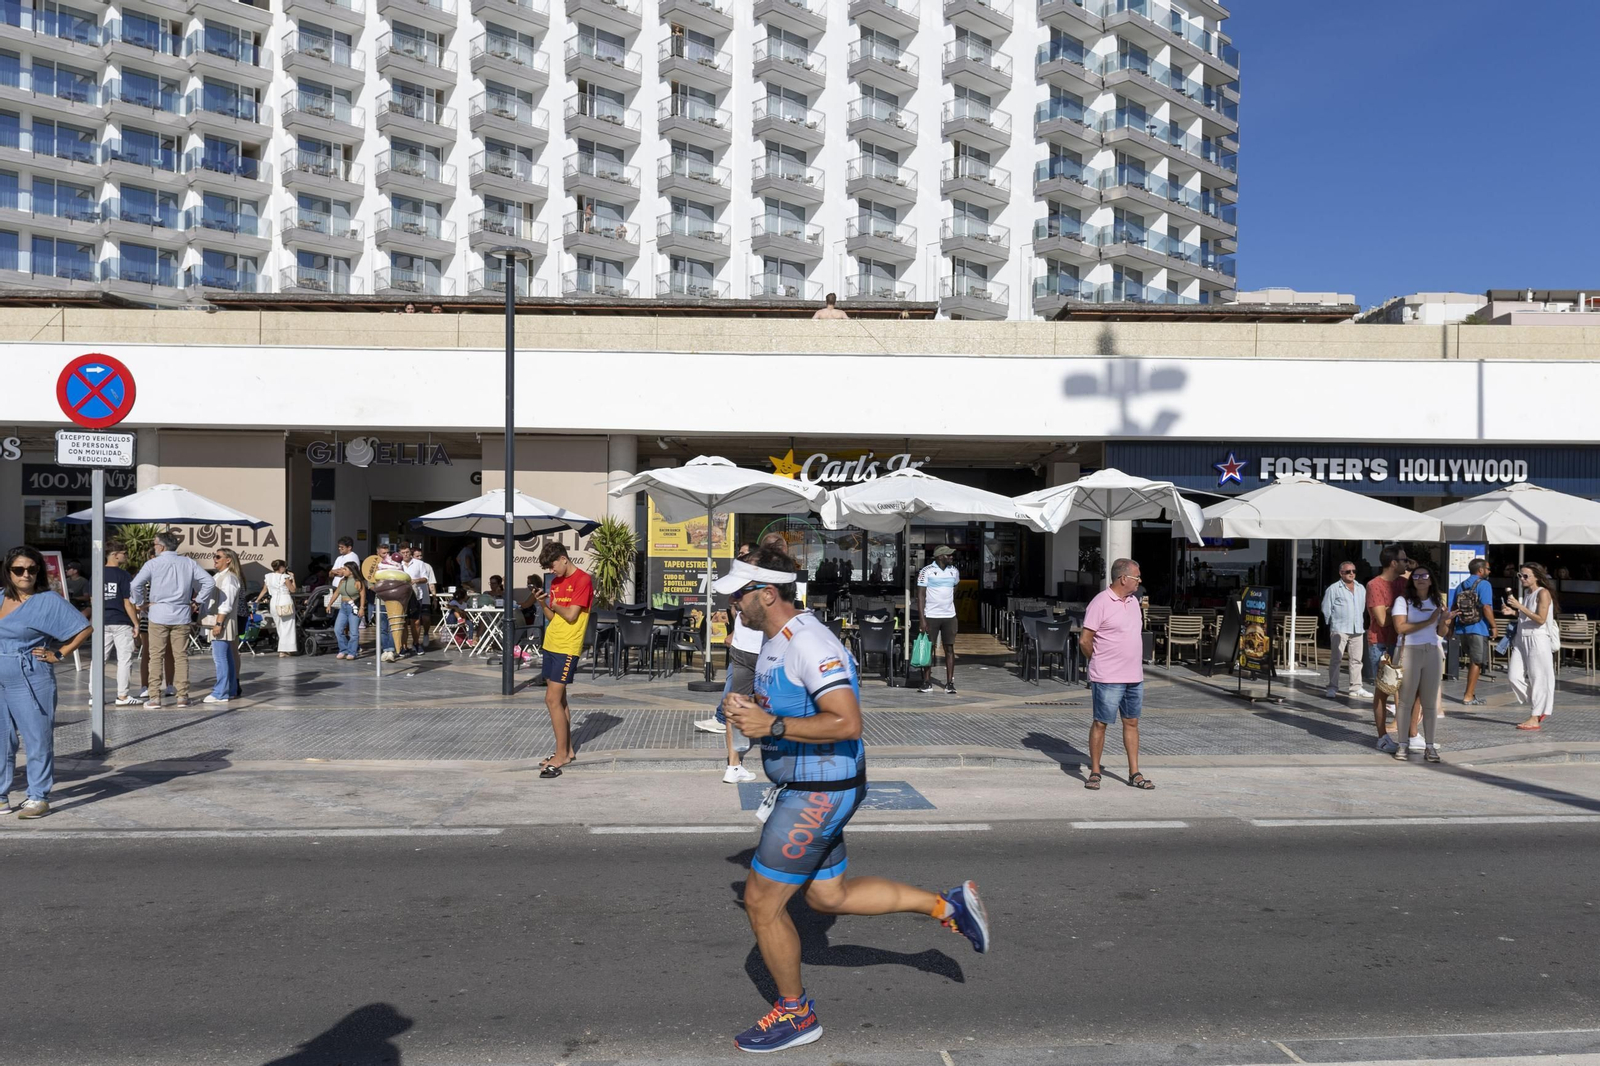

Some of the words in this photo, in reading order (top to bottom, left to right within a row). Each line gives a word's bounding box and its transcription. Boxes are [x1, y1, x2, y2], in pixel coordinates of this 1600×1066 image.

[29, 472, 69, 489] 100
[71, 470, 137, 490] MNTA
[800, 452, 881, 485] Carl's
[1260, 457, 1389, 482] FOSTER'S
[1399, 458, 1528, 483] HOLLYWOOD
[664, 560, 685, 568] TAPEO
[686, 561, 717, 569] ESTRELA
[561, 654, 573, 682] NABAIJ
[782, 791, 833, 859] COVAP
